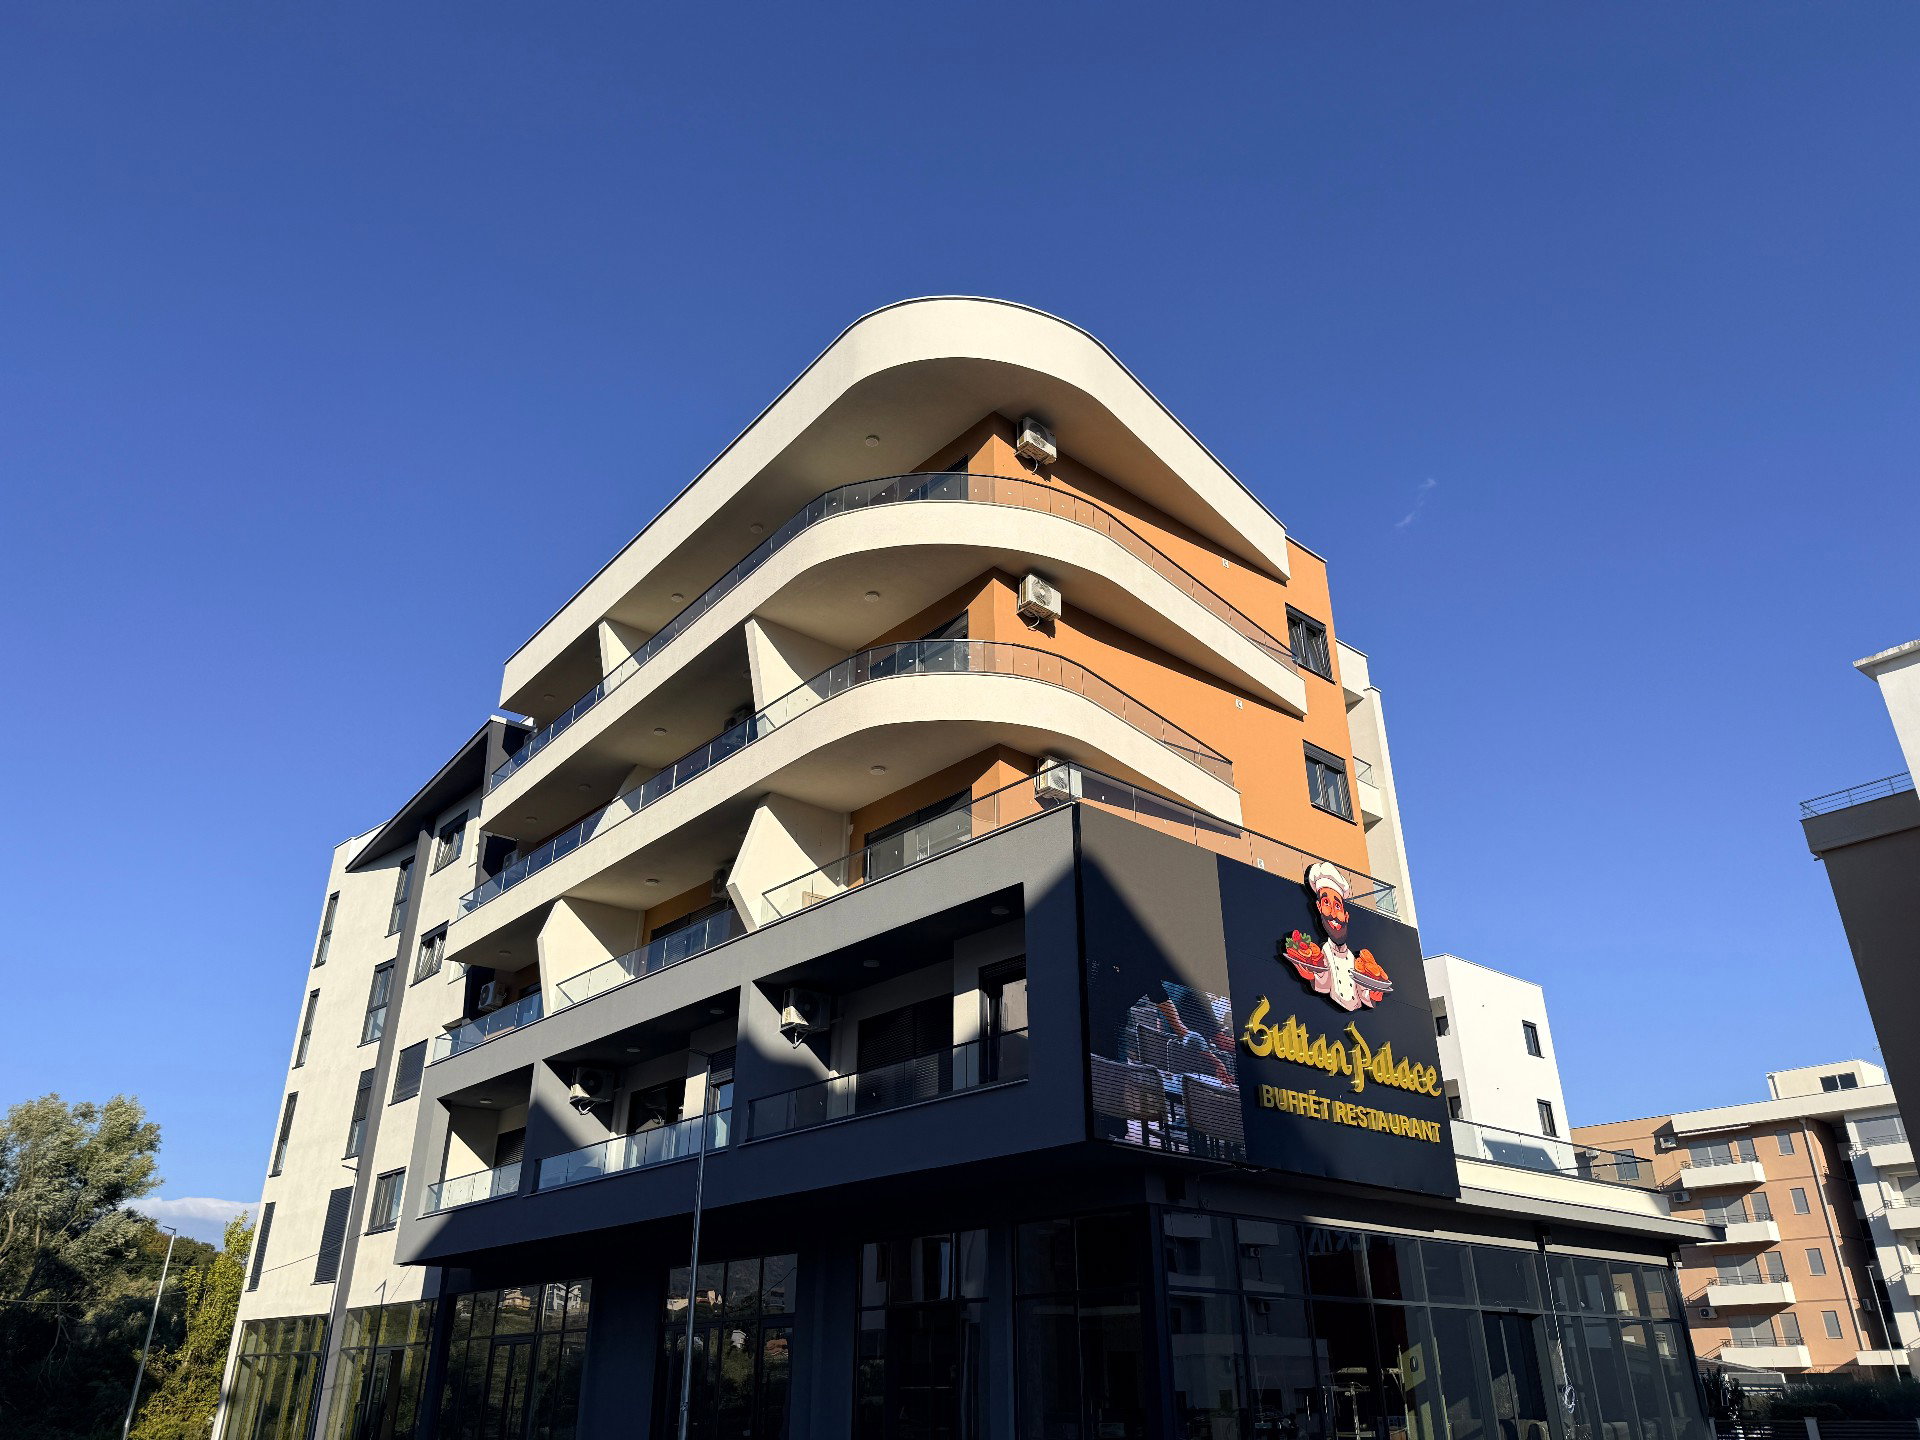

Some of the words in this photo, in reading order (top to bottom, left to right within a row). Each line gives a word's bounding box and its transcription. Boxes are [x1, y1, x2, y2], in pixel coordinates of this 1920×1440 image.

[1242, 994, 1351, 1077] Sultan
[1345, 1021, 1442, 1097] Palace
[1332, 1100, 1441, 1143] RESTAURANT
